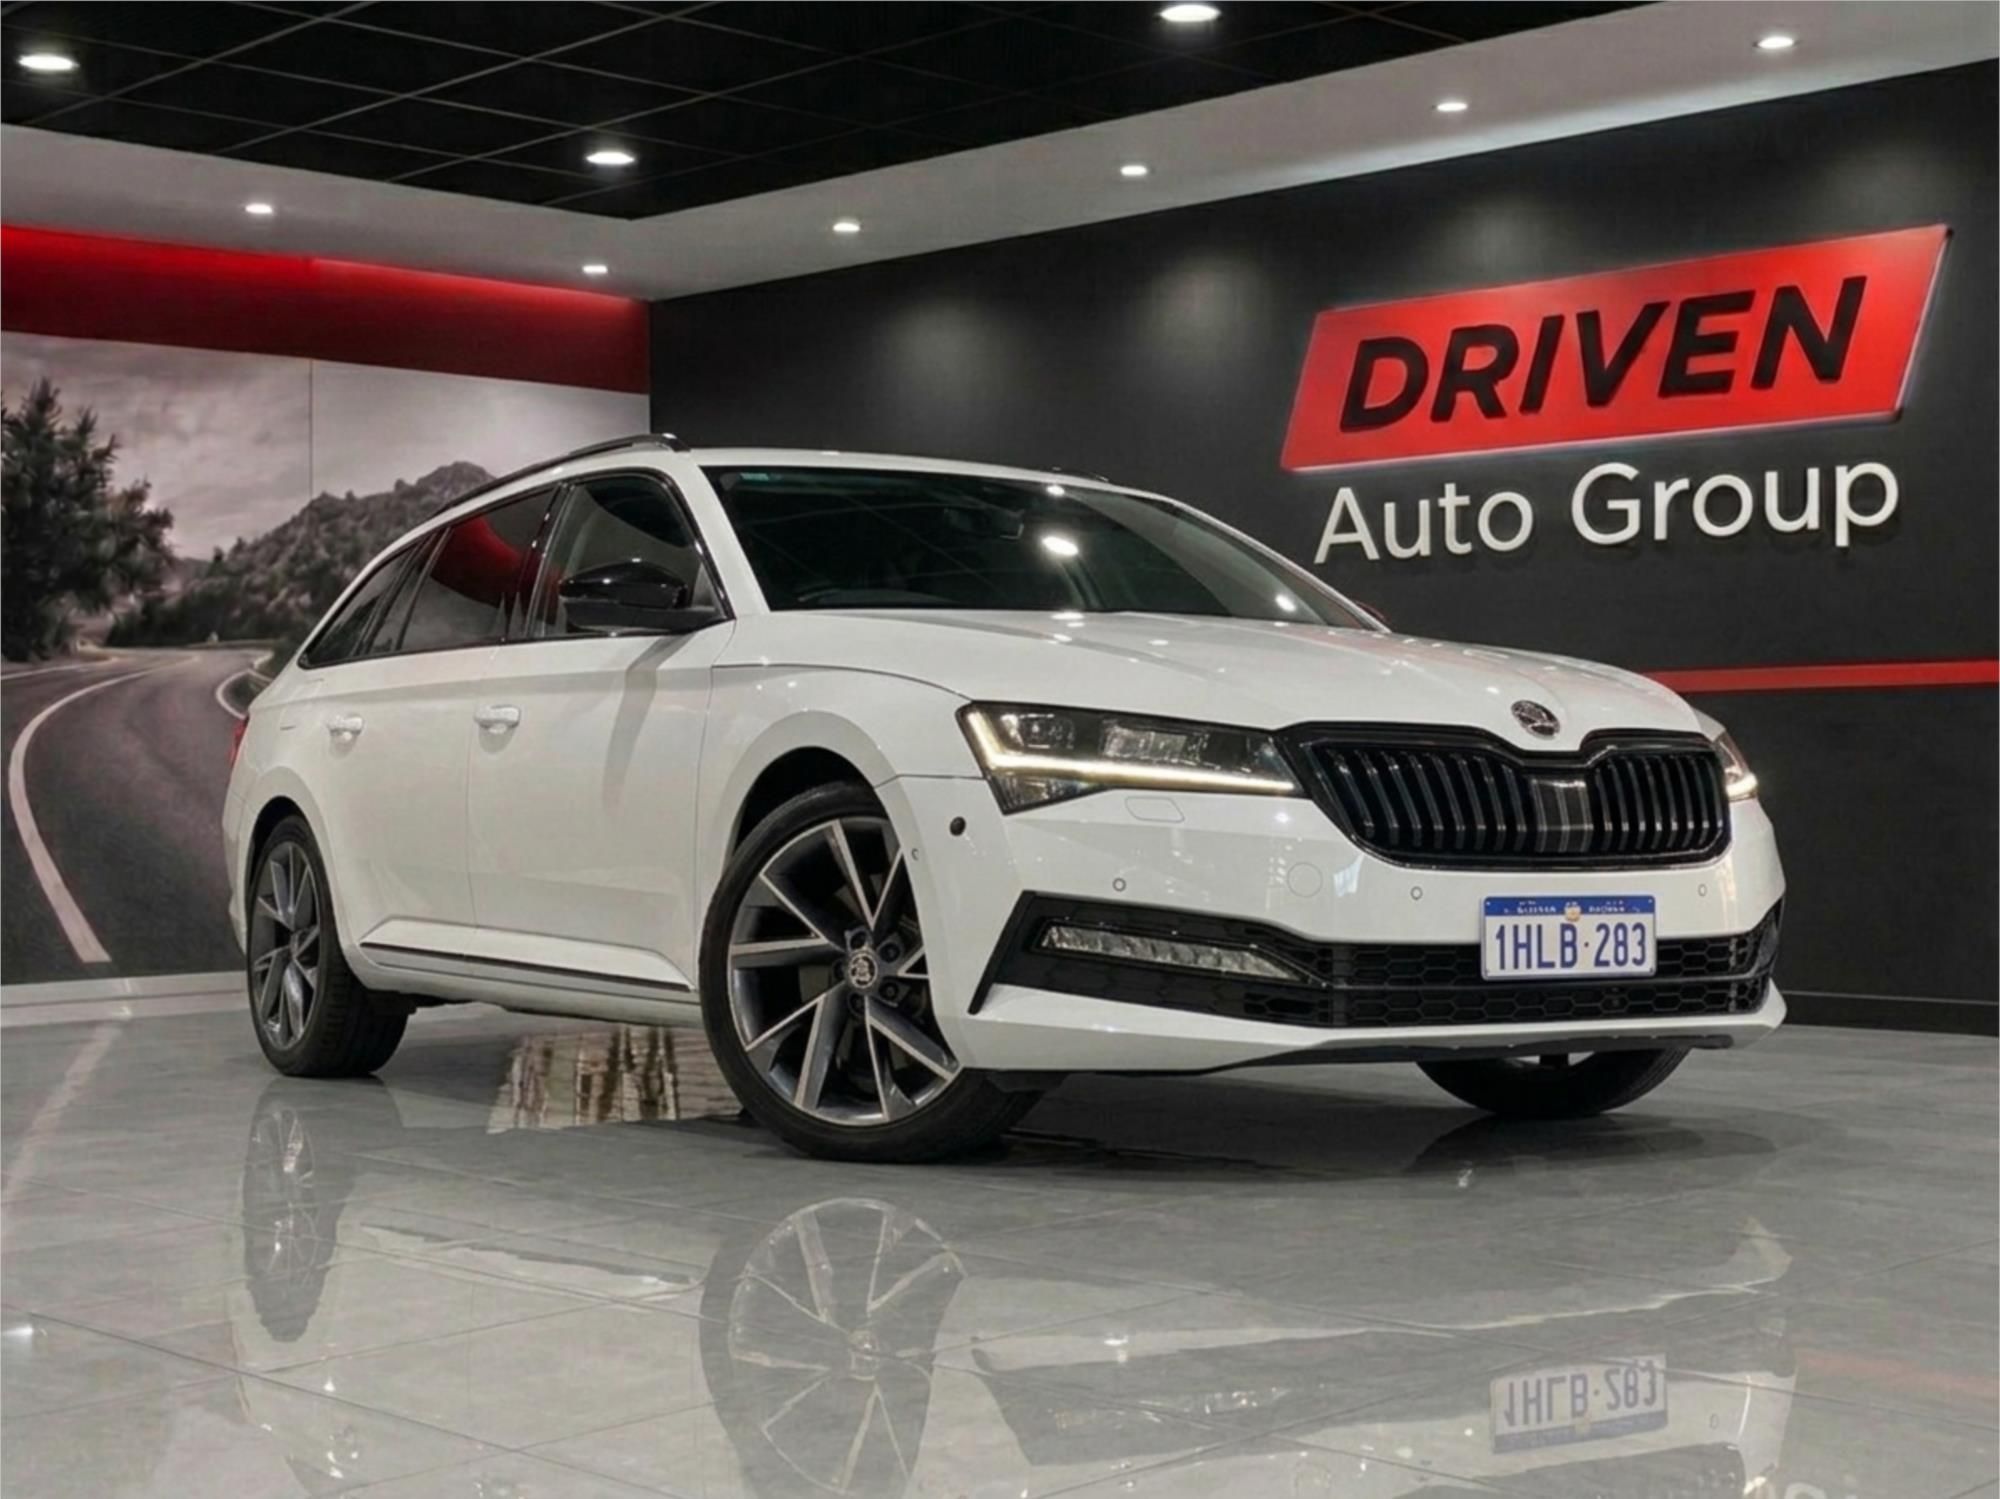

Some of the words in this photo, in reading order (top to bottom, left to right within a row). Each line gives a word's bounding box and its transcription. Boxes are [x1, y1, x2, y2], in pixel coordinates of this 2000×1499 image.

[1340, 276, 1867, 433] DRIVEN
[1314, 483, 1533, 564] Auto
[1571, 461, 1899, 547] Group
